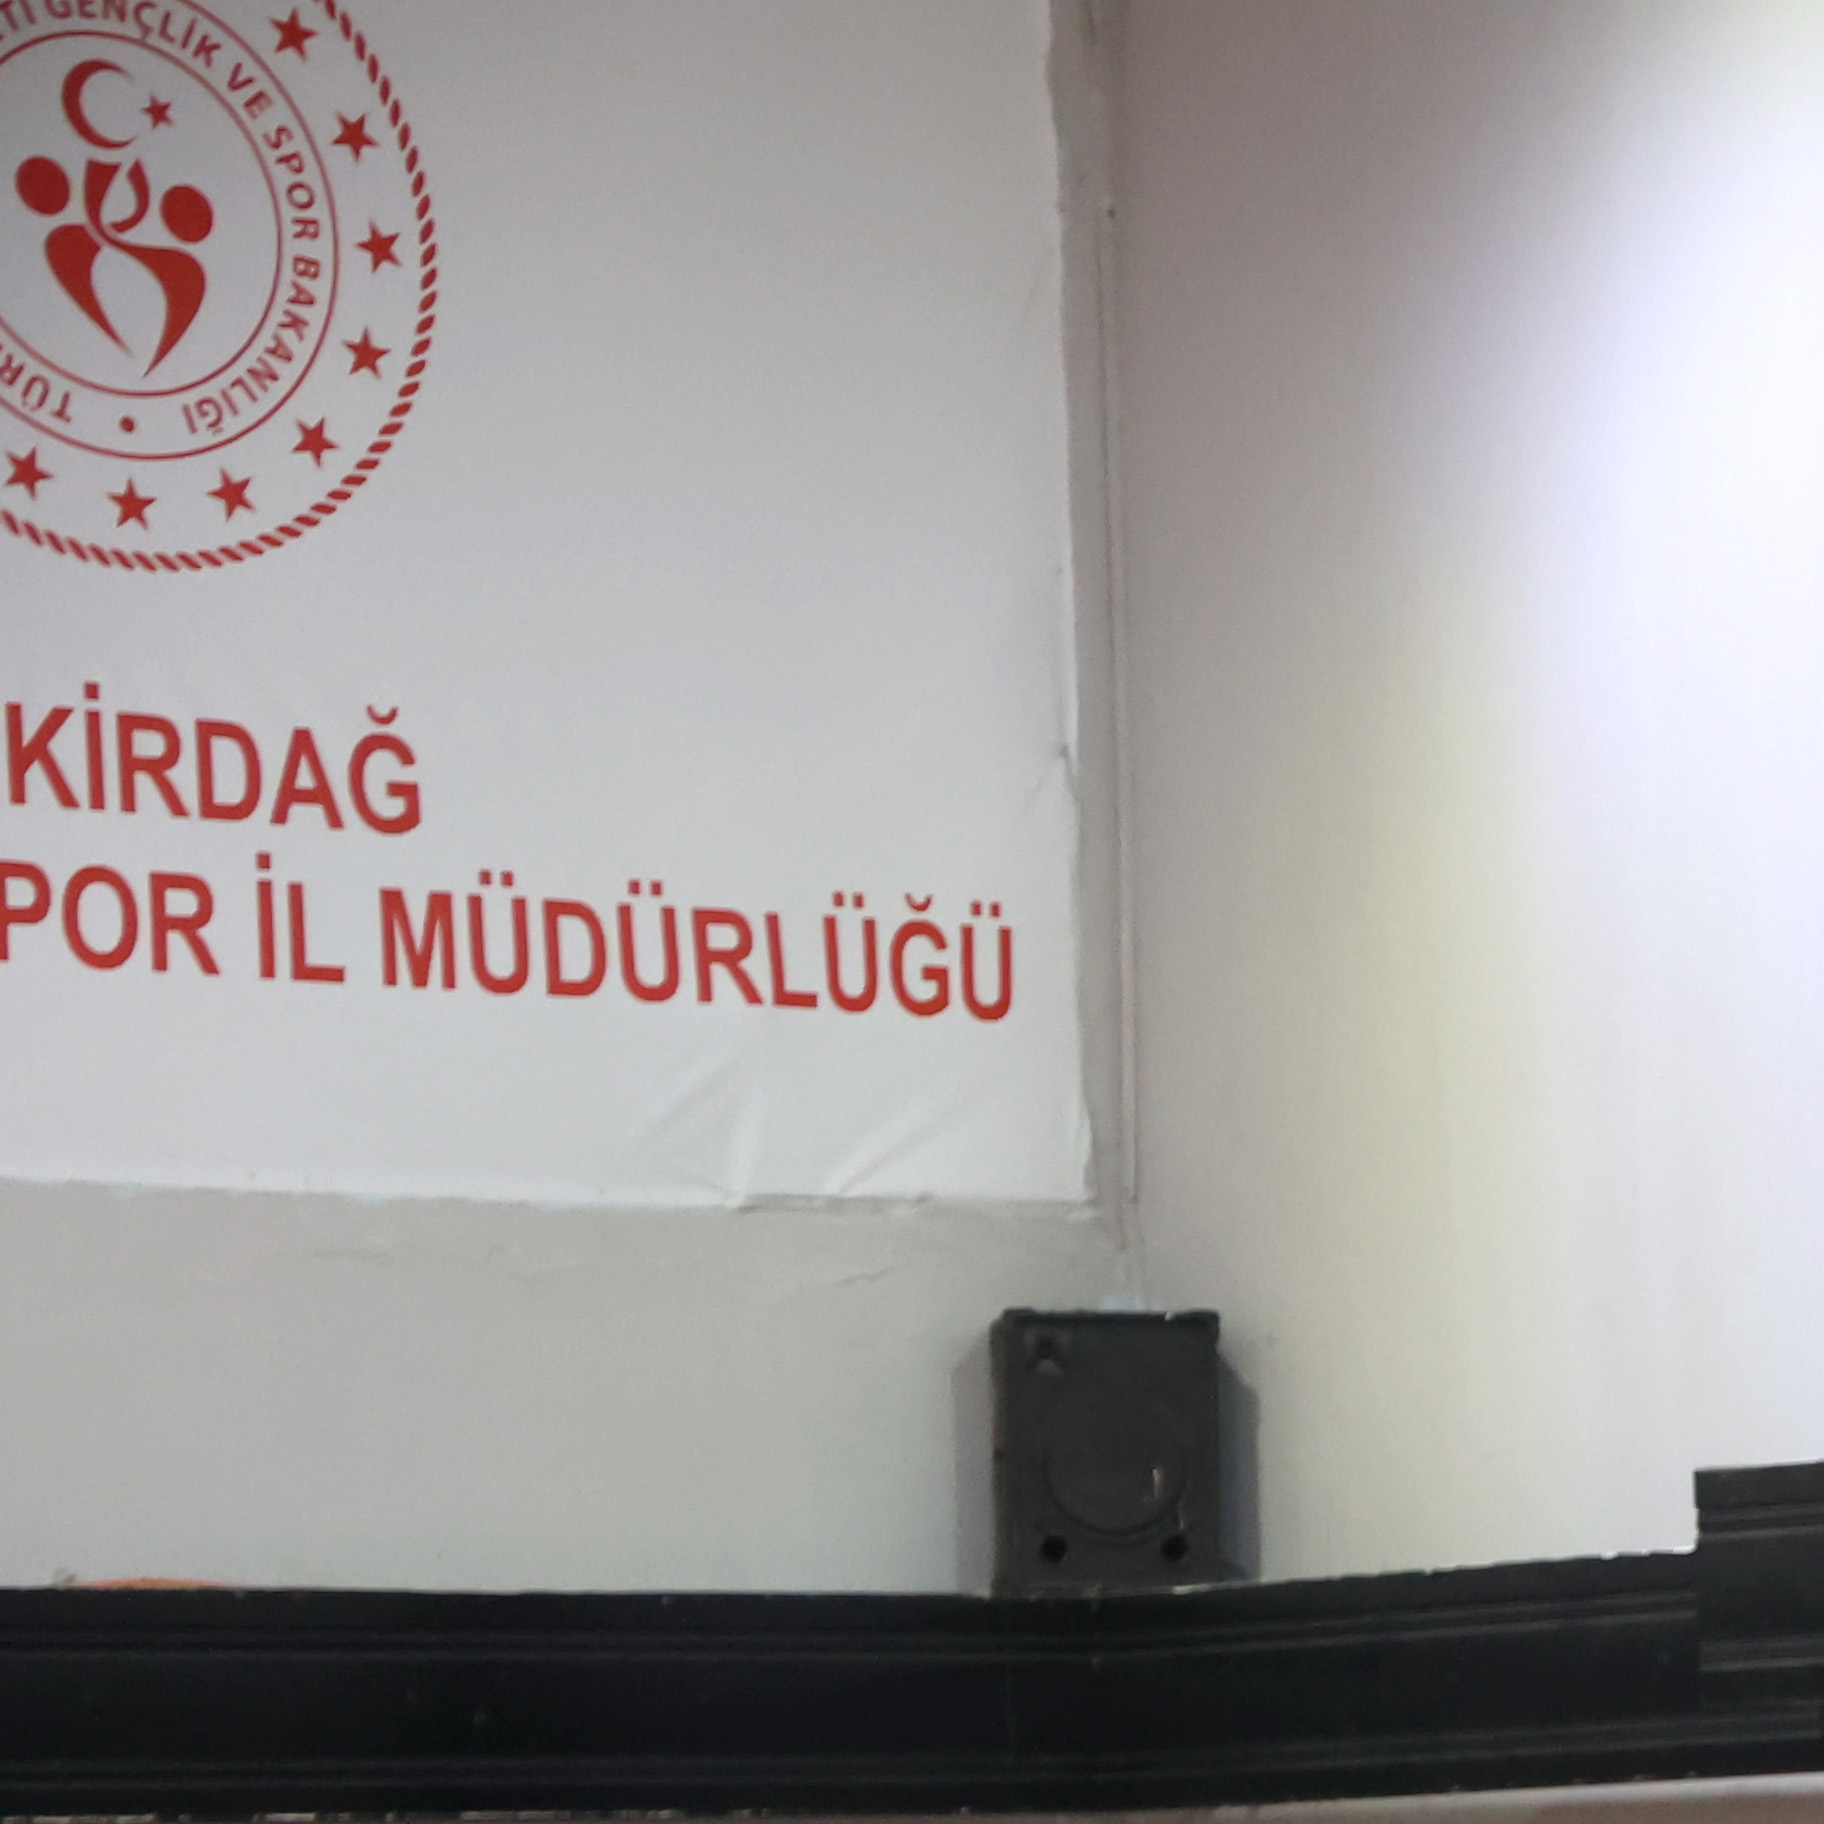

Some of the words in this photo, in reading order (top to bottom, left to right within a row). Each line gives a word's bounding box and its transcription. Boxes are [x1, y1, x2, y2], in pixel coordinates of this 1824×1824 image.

[227, 61, 274, 121] VE
[262, 124, 321, 241] SPOR
[5, 681, 421, 837] KİRDAĞ
[255, 851, 346, 983] İL
[379, 869, 1013, 1021] MÜDÜRLÜĞÜ
